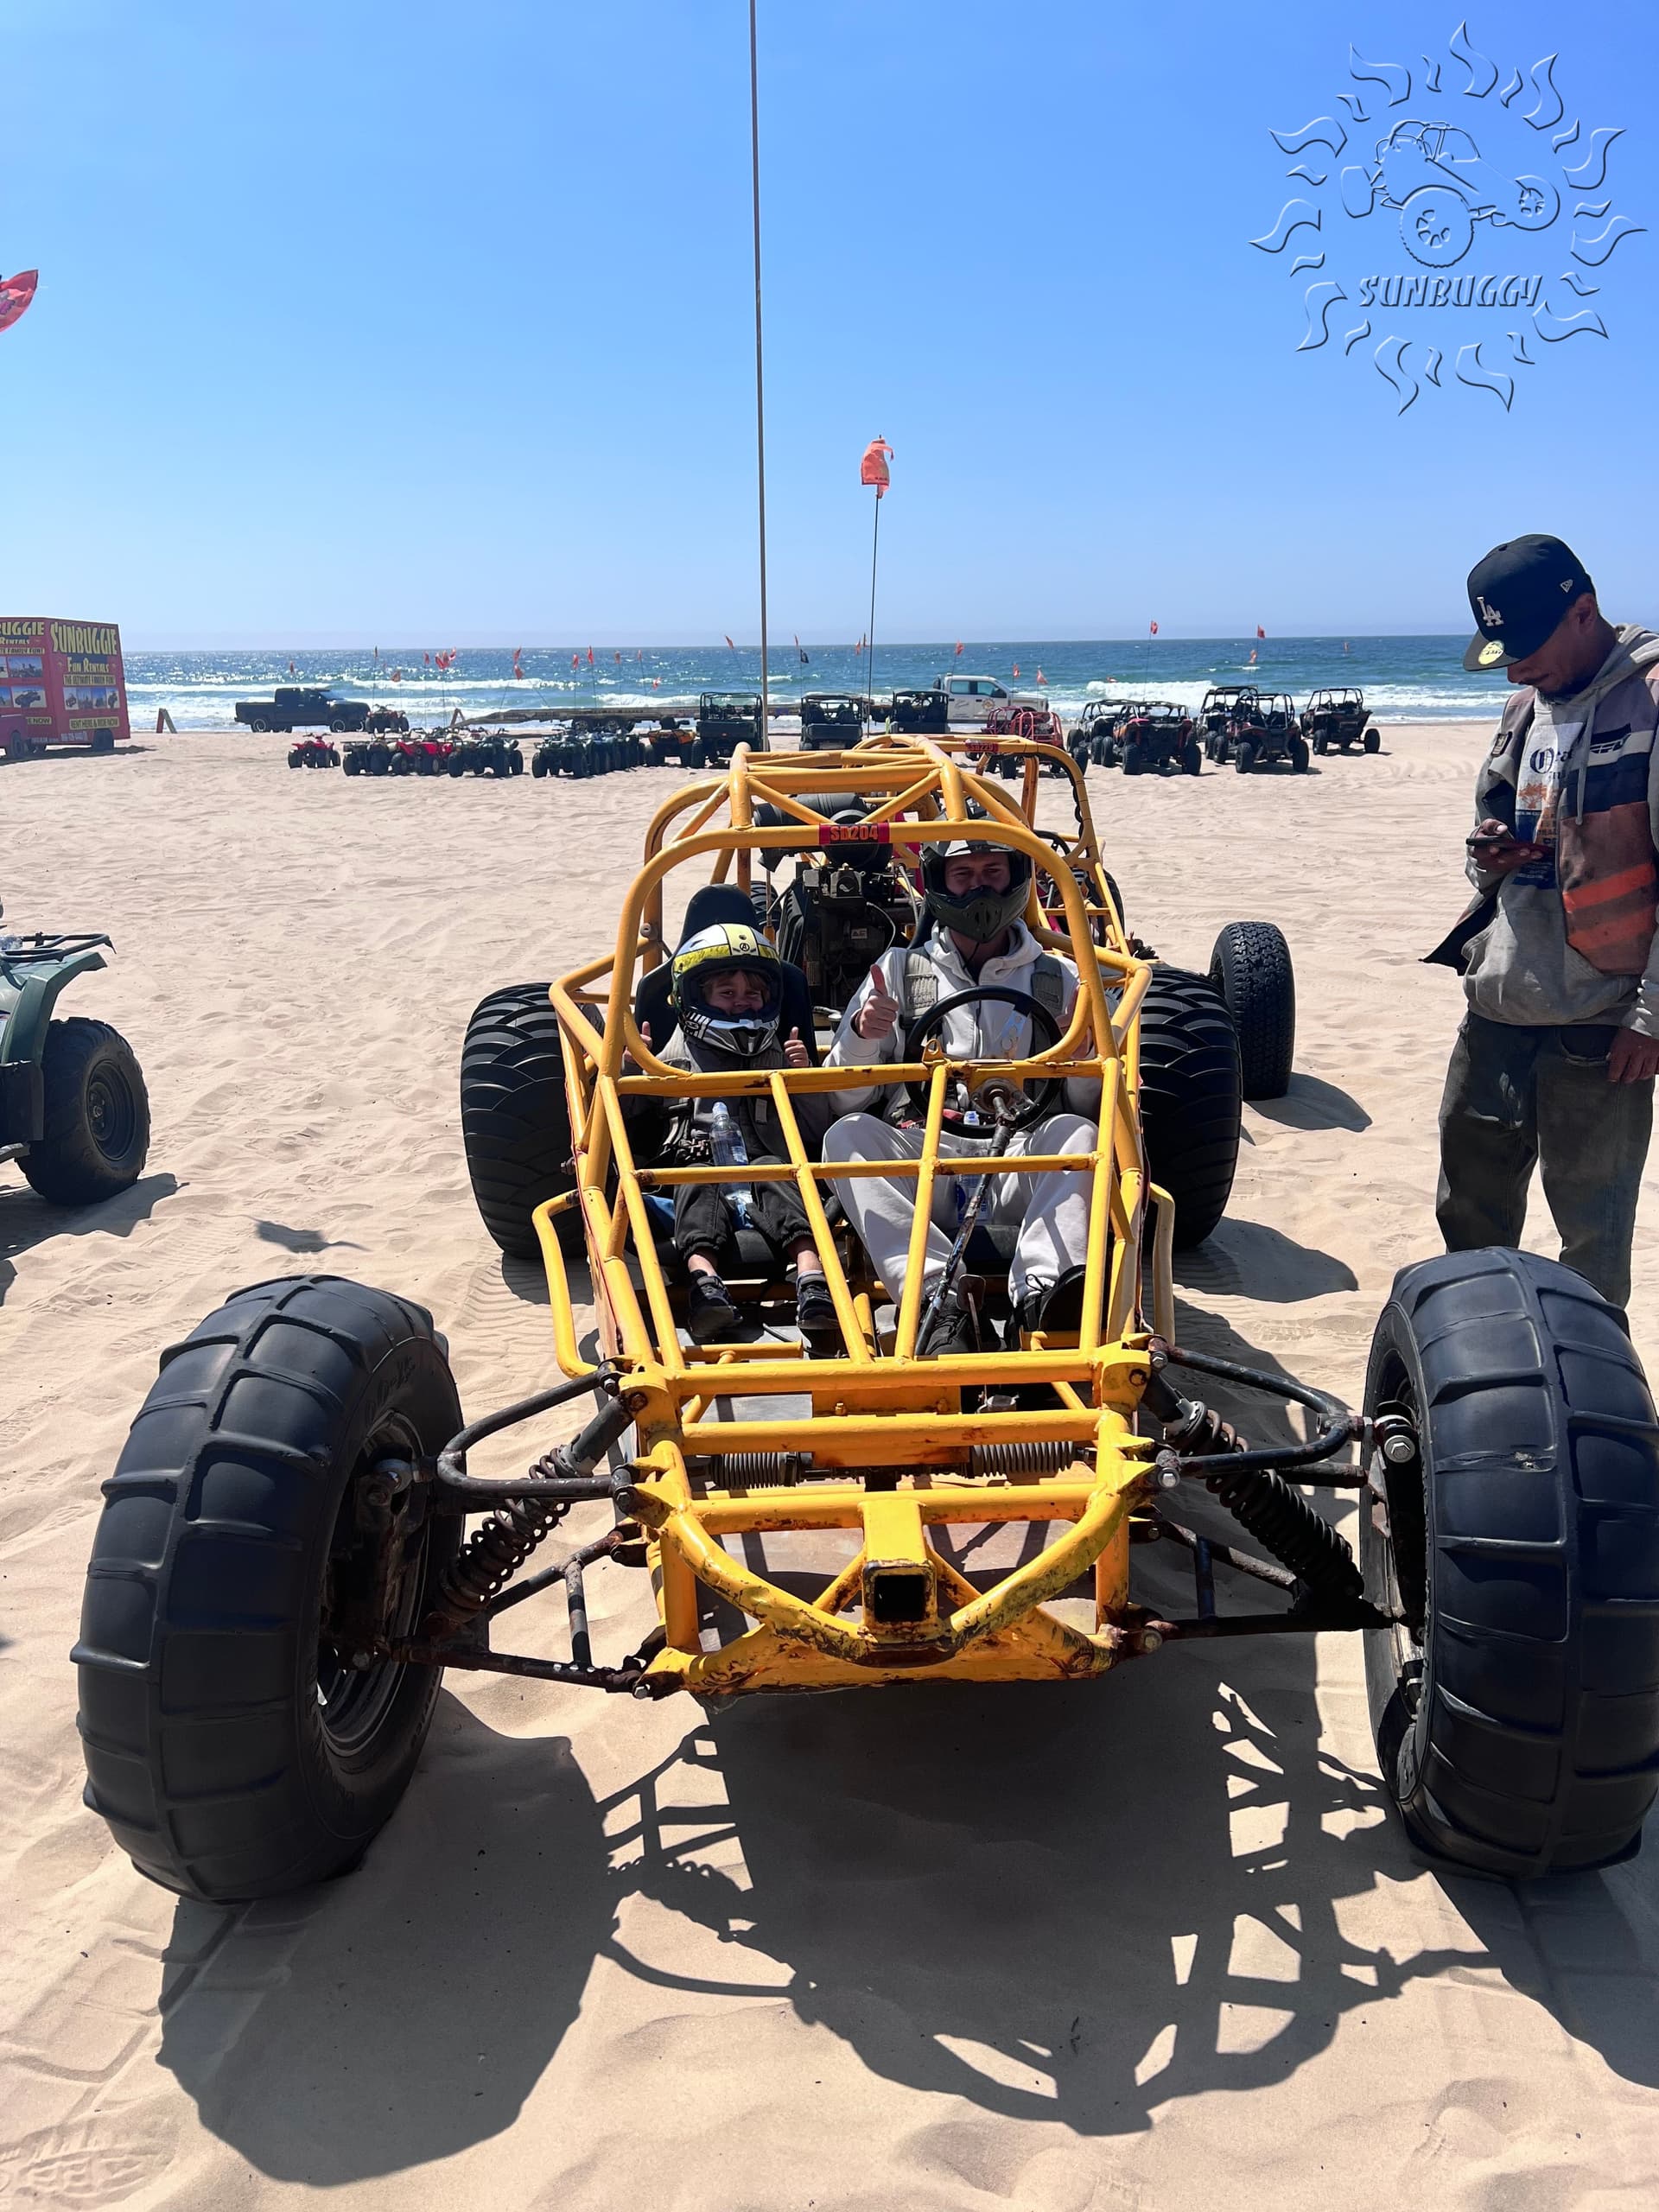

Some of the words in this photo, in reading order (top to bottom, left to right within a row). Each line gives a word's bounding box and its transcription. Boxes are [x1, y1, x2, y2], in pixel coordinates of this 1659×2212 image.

[1476, 595, 1504, 627] LA
[0, 621, 44, 636] UGGIE
[50, 621, 118, 656] SUNBUGGIE
